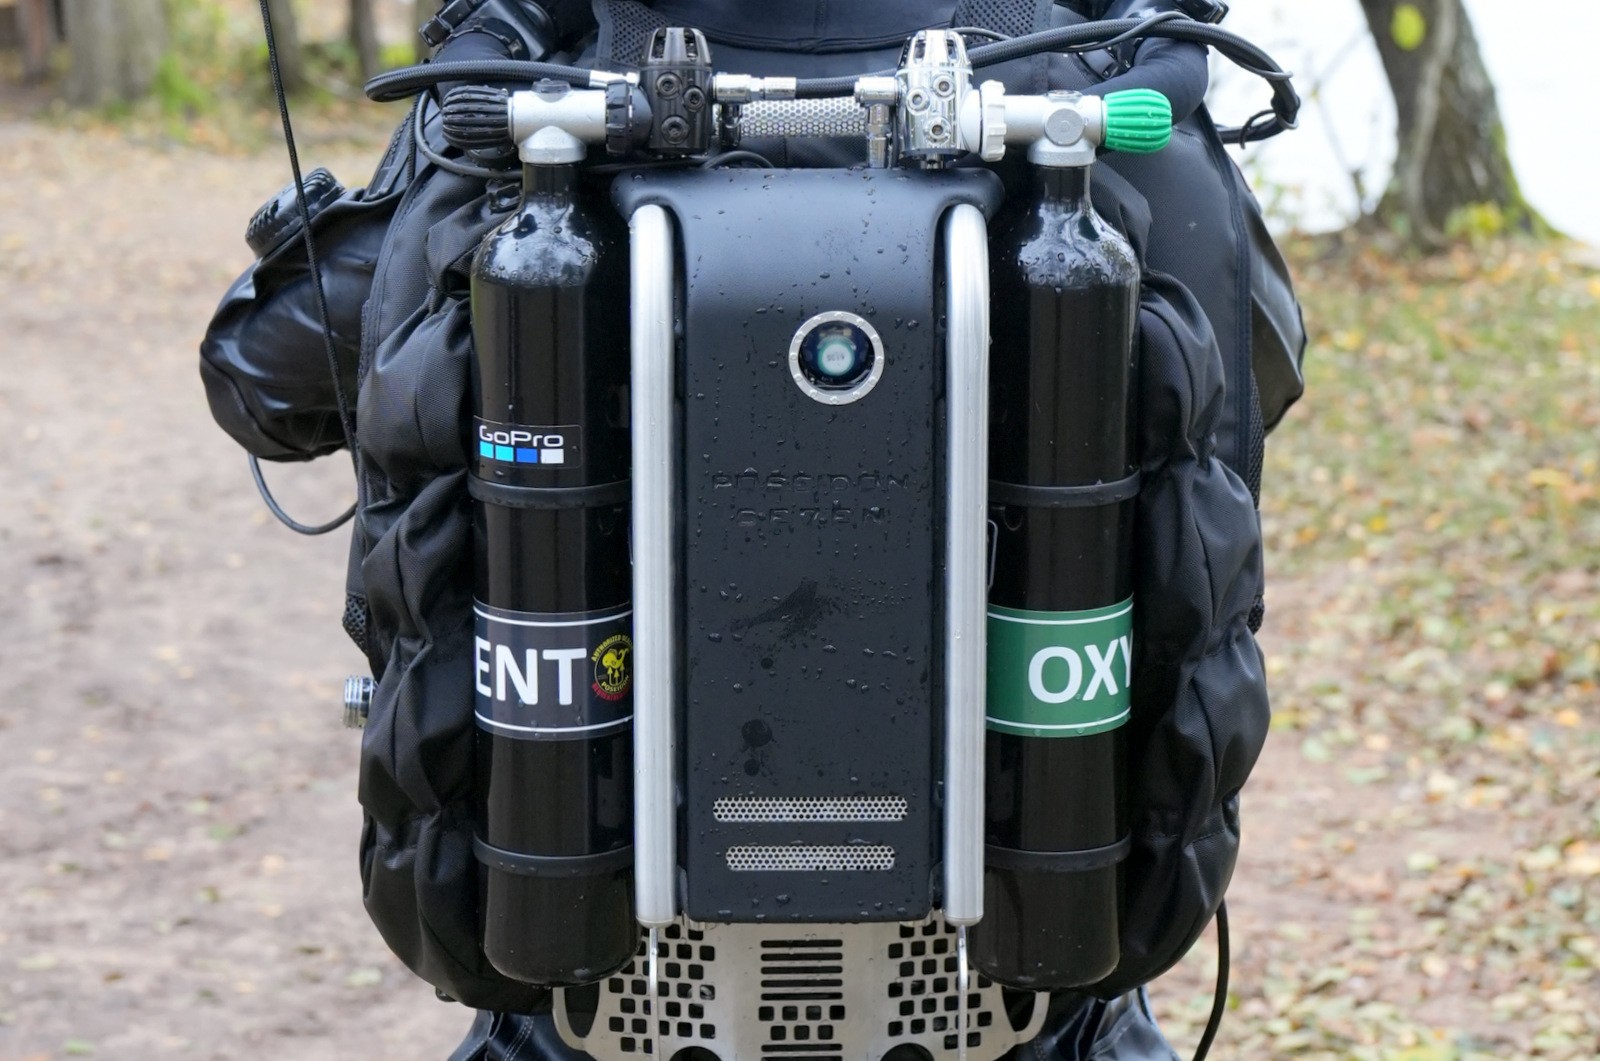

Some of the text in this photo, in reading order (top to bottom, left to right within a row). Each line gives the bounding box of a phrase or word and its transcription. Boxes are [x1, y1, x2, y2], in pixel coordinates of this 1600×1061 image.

[479, 425, 564, 447] GoPro
[711, 473, 909, 491] POSEIDON
[591, 634, 622, 662] AUTHORIZED
[475, 636, 587, 705] ENT
[1028, 629, 1133, 704] OXY
[601, 674, 630, 692] POSEIDON
